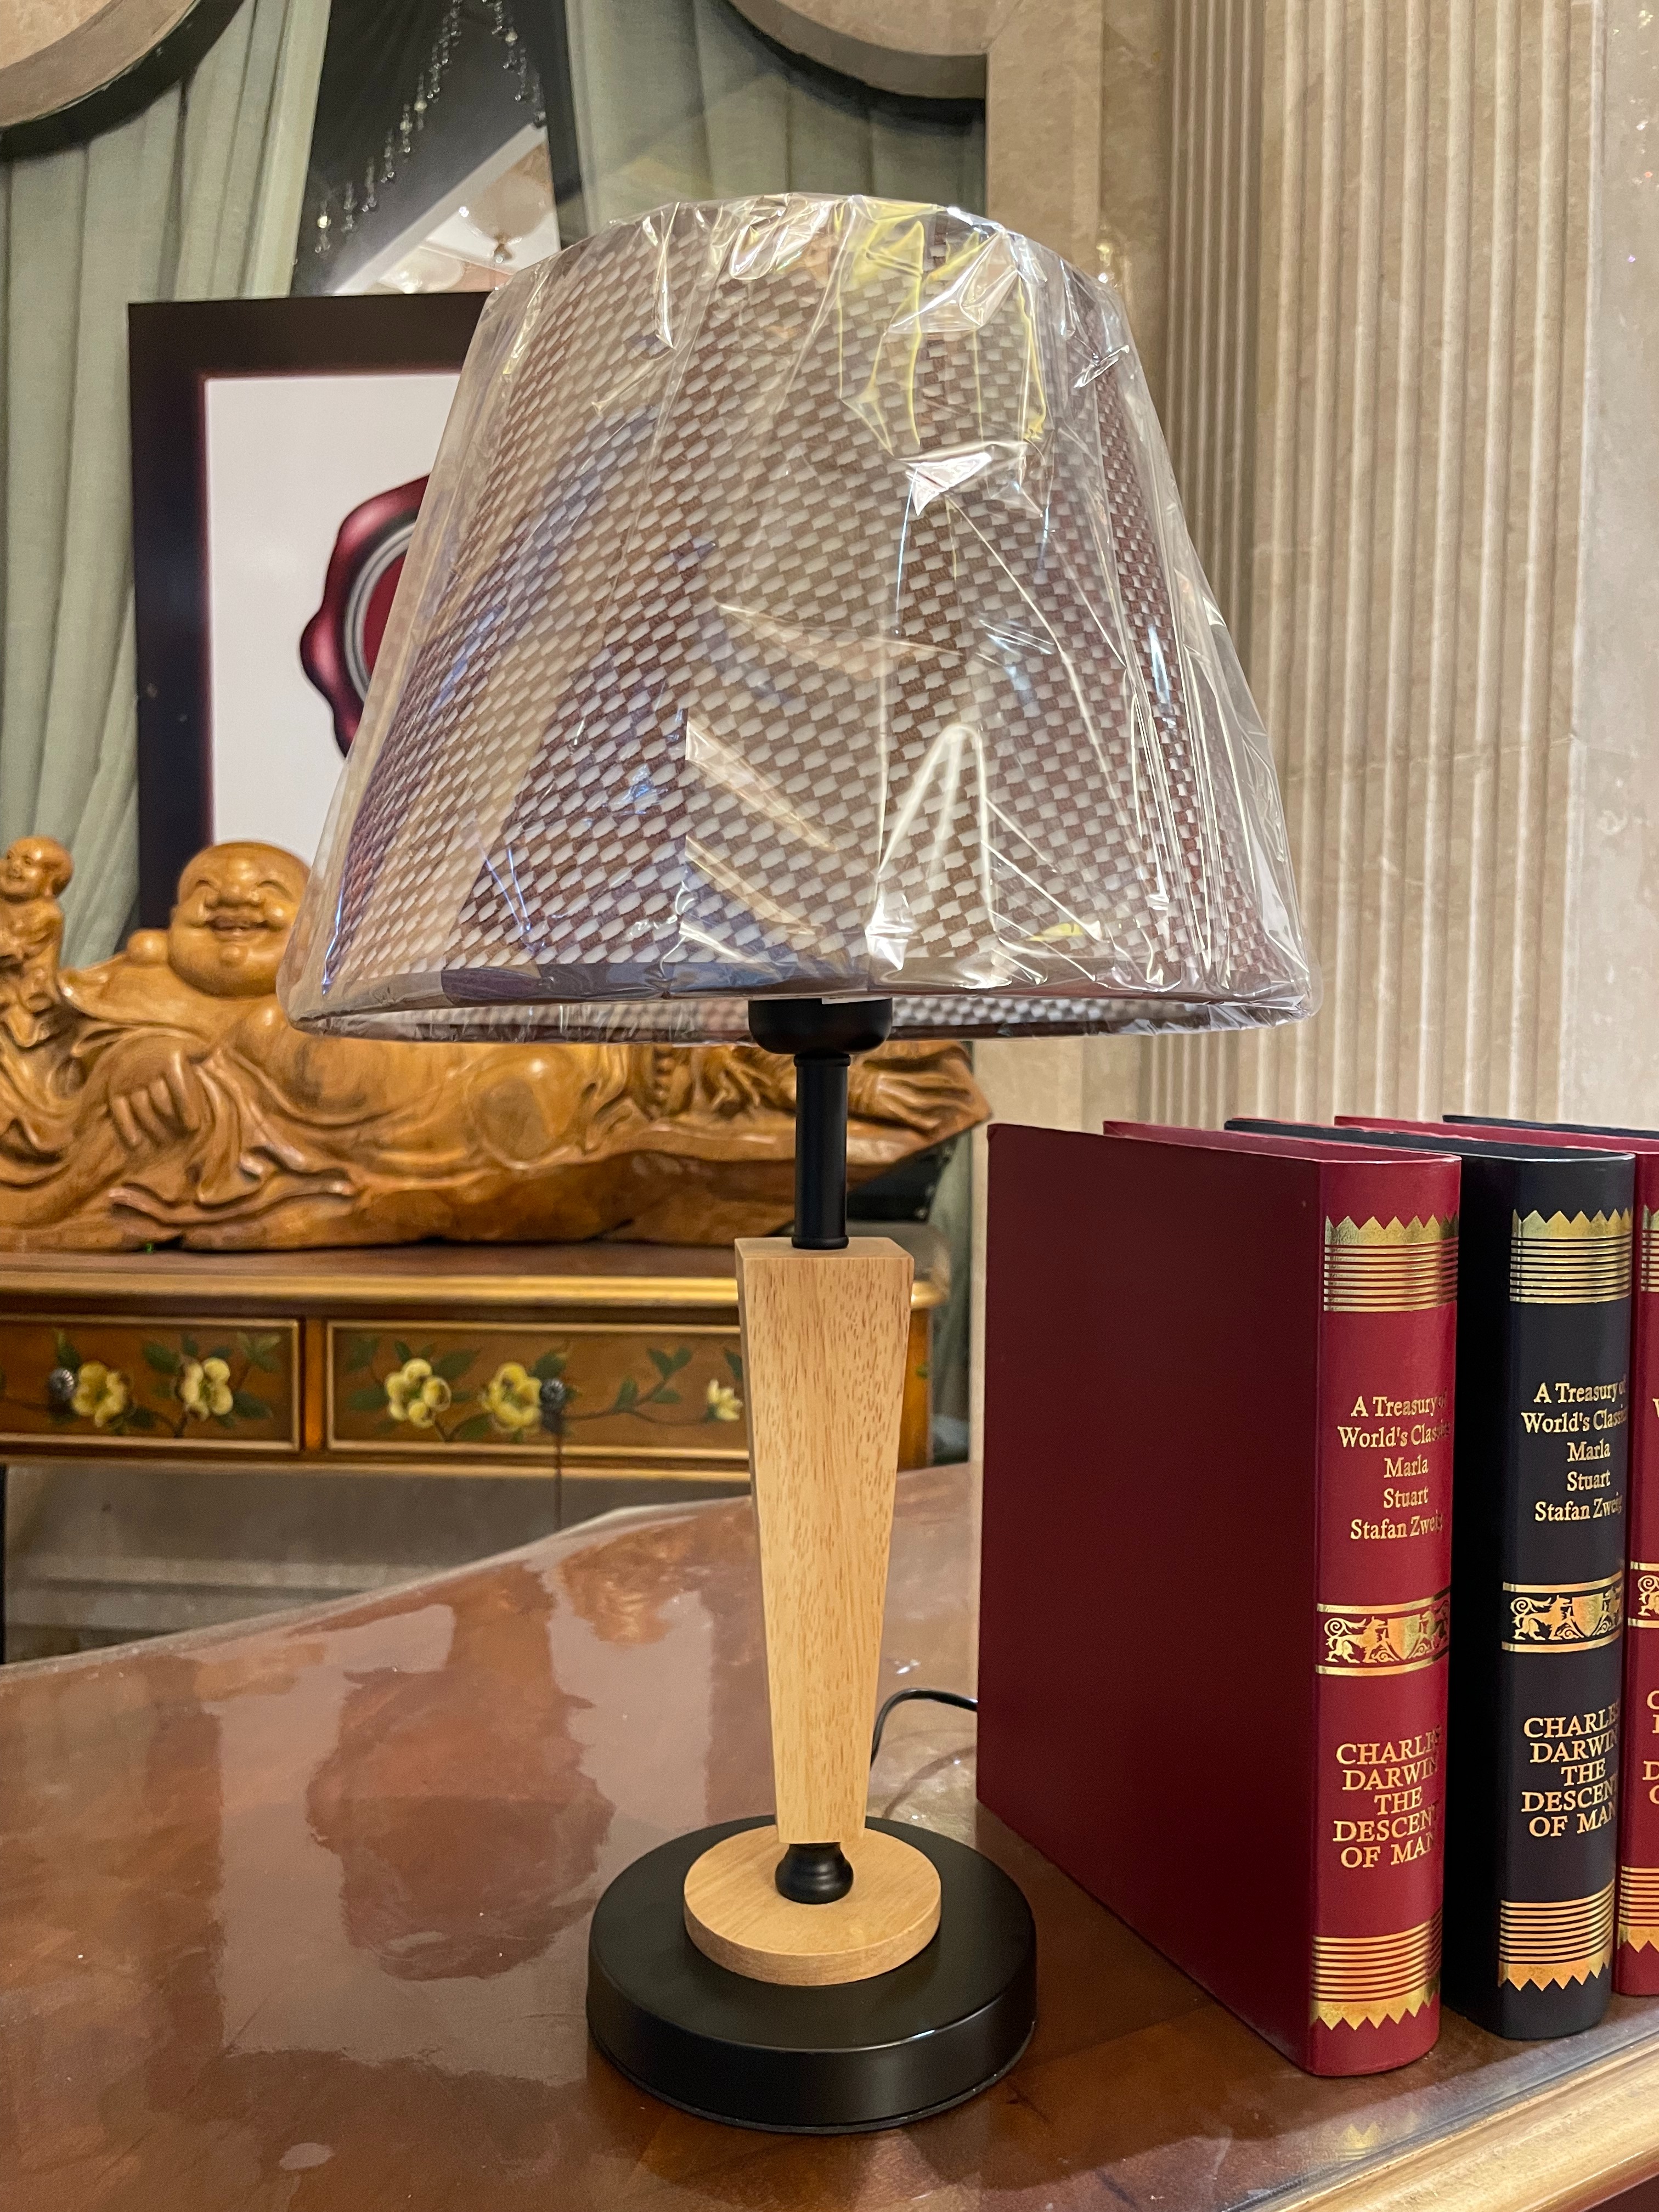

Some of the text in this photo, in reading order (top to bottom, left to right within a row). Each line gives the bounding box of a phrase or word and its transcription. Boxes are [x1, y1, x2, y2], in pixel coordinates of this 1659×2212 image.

[1533, 1383, 1552, 1403] A
[1555, 1382, 1618, 1403] Treasury
[1351, 1396, 1369, 1417] A
[1373, 1396, 1437, 1417] Treasury
[1521, 1412, 1590, 1434] World's
[1337, 1426, 1408, 1448] World's
[1567, 1438, 1611, 1462] Marla
[1384, 1454, 1429, 1478] Marla
[1567, 1469, 1611, 1492] Stuart
[1384, 1486, 1429, 1509] Stuart
[1534, 1491, 1623, 1522] Stafan Zweig
[1350, 1518, 1408, 1540] Stafan
[1523, 1701, 1617, 1739] CHARLE
[1530, 1724, 1618, 1763] DARWIN
[1342, 1757, 1437, 1791] DARWIN
[1561, 1758, 1606, 1786] THE
[1374, 1786, 1423, 1815] THE
[1529, 1801, 1616, 1837] OF MAN
[1341, 1846, 1381, 1868] OF
